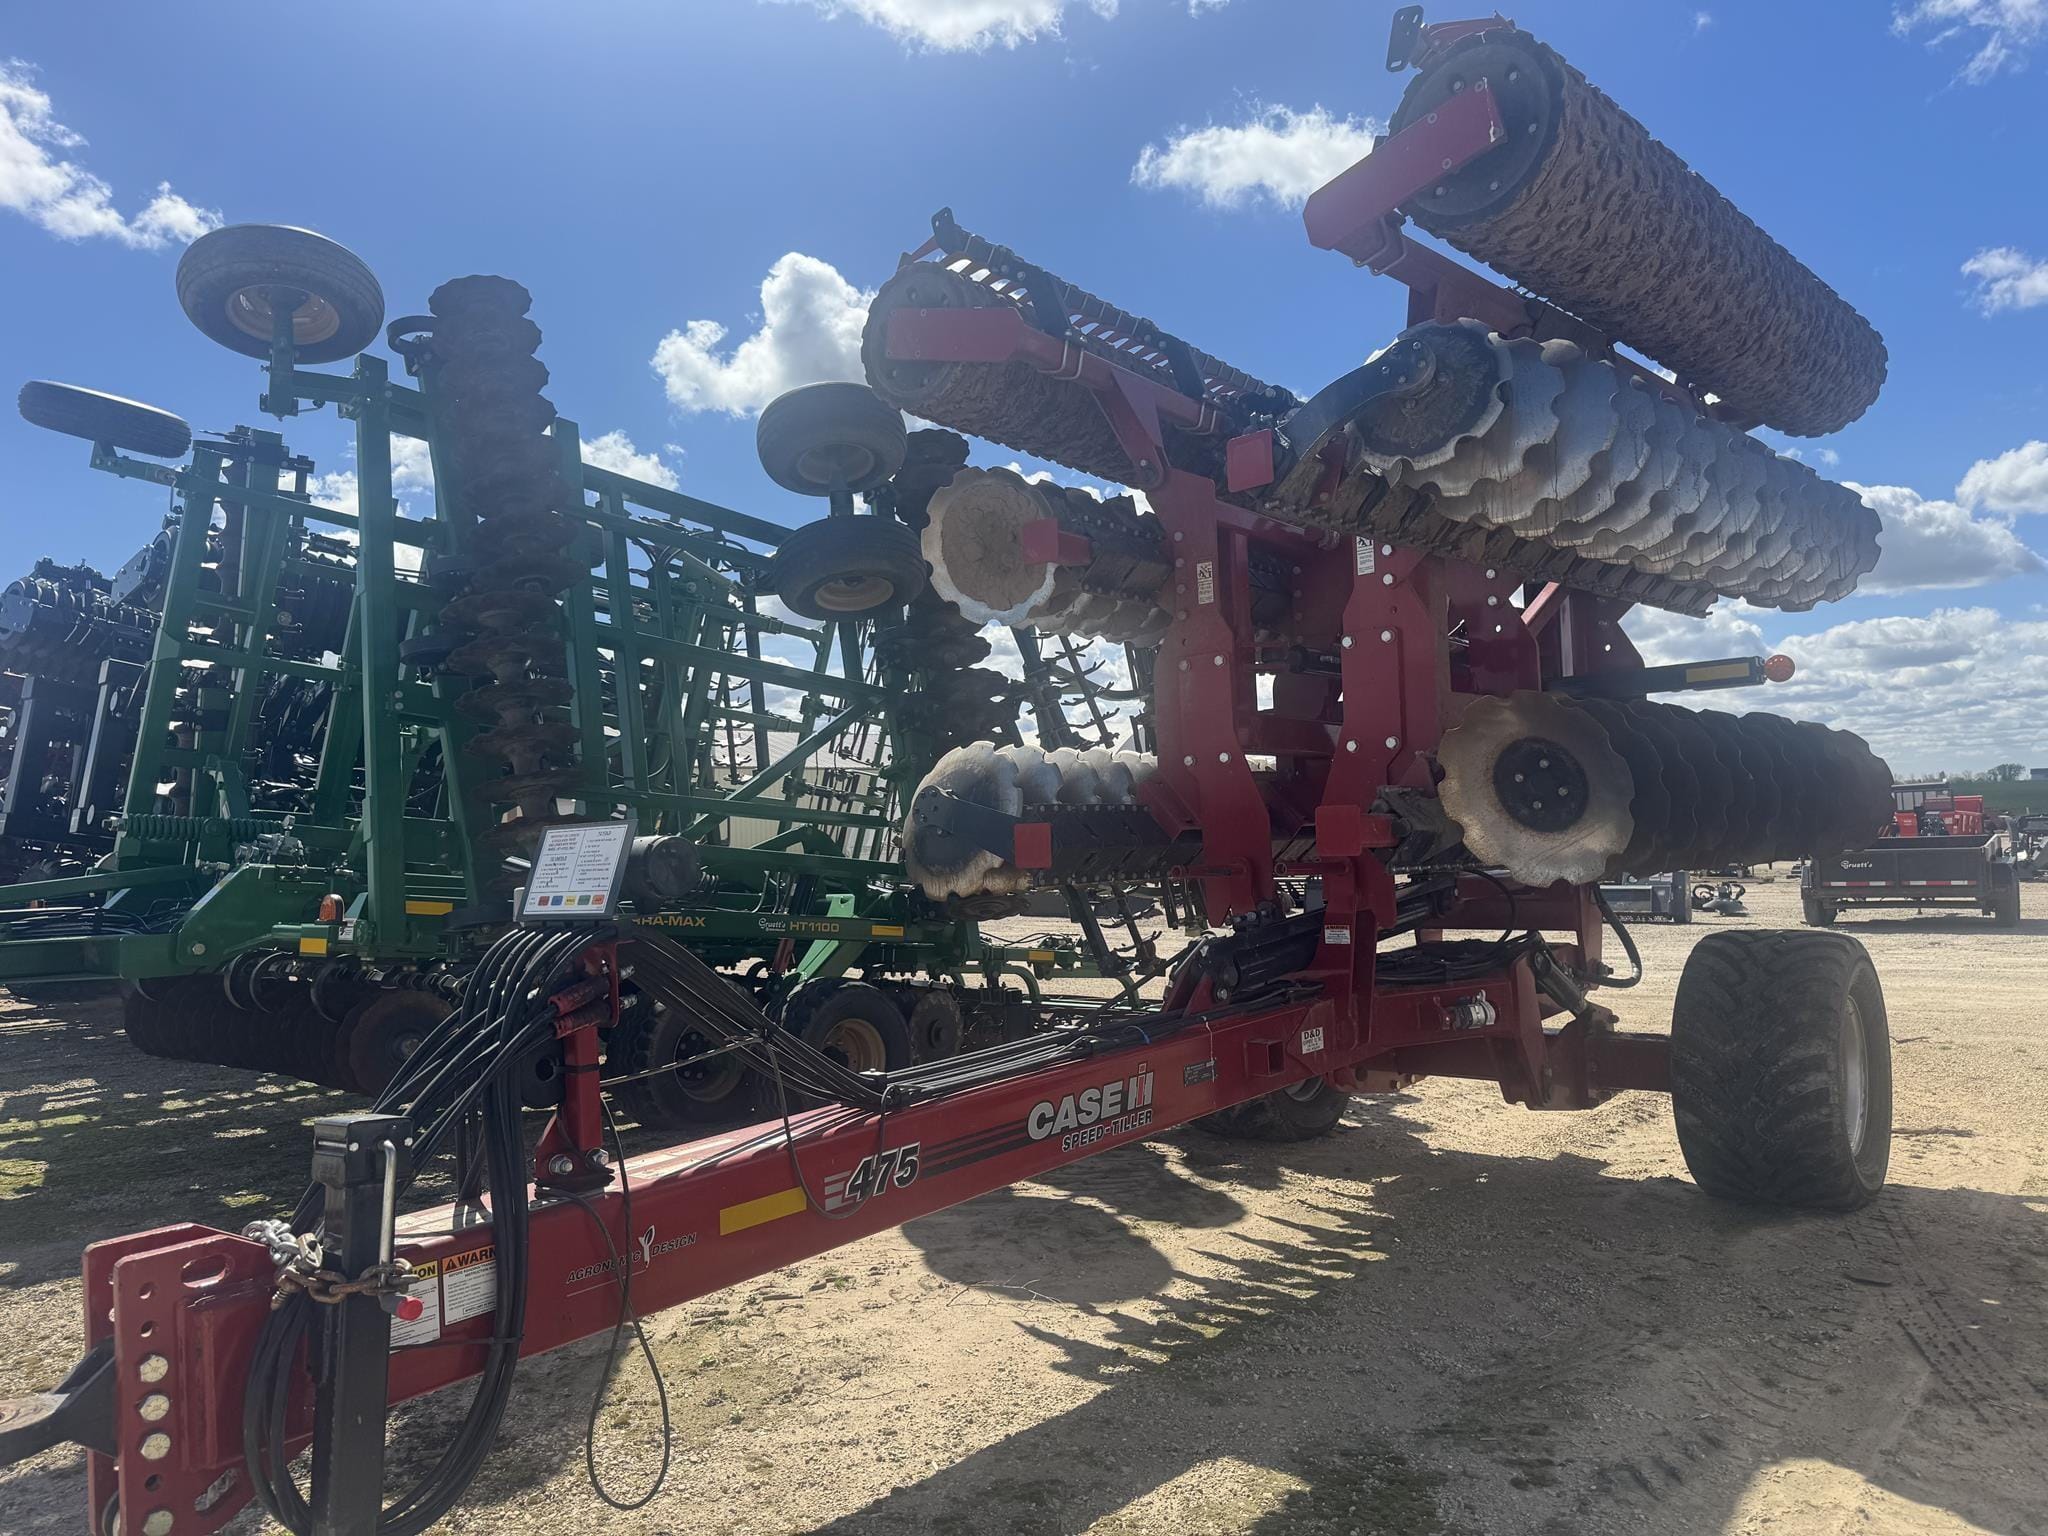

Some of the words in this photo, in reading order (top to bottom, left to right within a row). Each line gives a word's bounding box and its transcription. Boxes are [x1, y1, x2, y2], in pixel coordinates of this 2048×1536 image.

[789, 920, 840, 933] HT1100
[1027, 1080, 1123, 1140] CASE
[1062, 1108, 1153, 1153] SPEED-TILLER
[845, 1141, 921, 1203] 475
[457, 1247, 497, 1267] WARN
[651, 1232, 697, 1257] DESIGN
